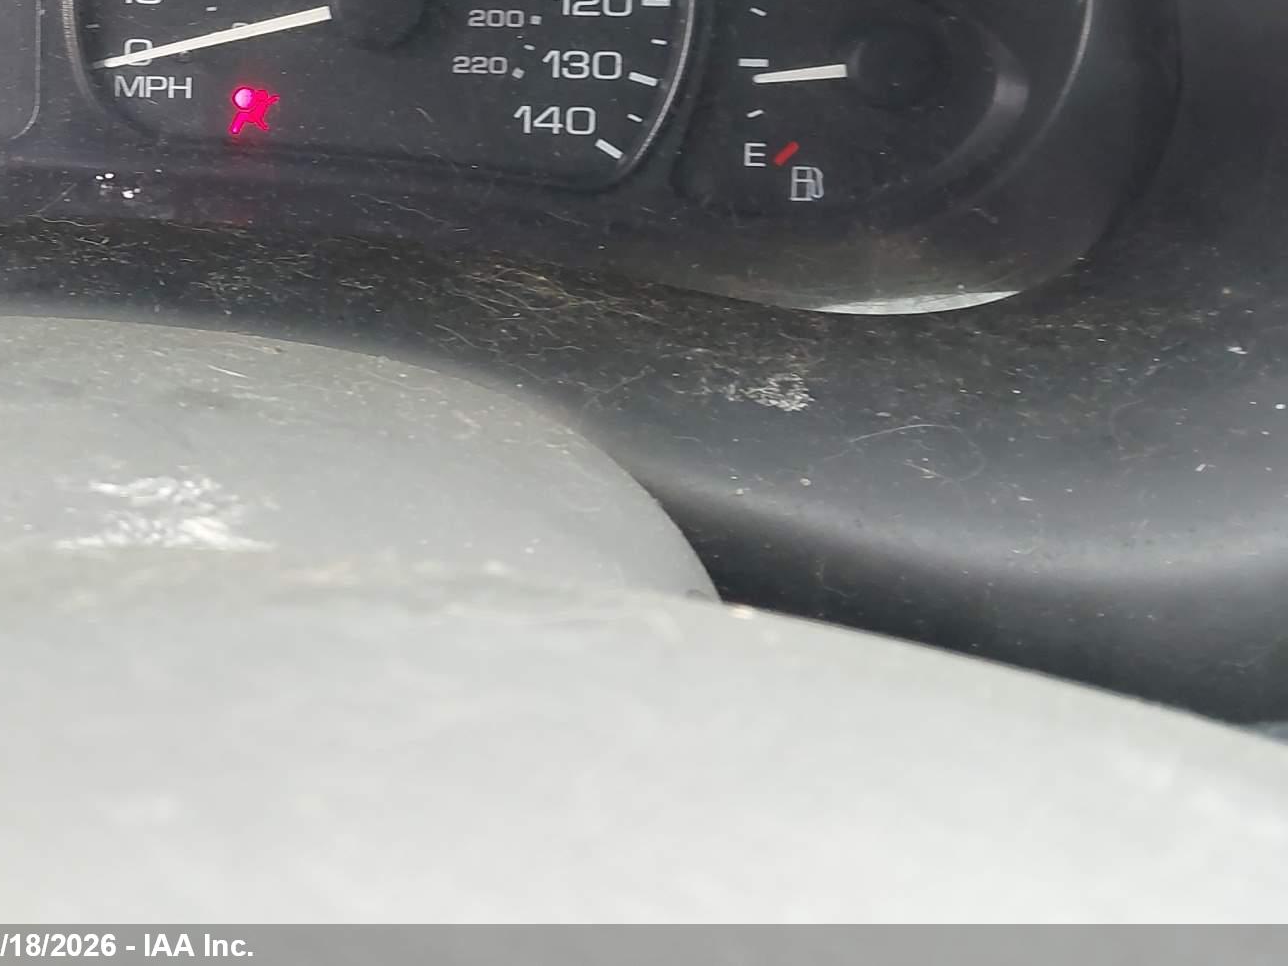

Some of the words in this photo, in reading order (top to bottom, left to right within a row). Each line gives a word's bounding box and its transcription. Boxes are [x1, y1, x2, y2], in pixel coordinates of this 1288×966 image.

[468, 10, 524, 27] 200
[124, 38, 153, 66] 0
[453, 56, 507, 74] 220
[543, 51, 621, 79] 130
[116, 76, 192, 98] MPH
[514, 106, 595, 134] 140
[744, 143, 766, 166] E
